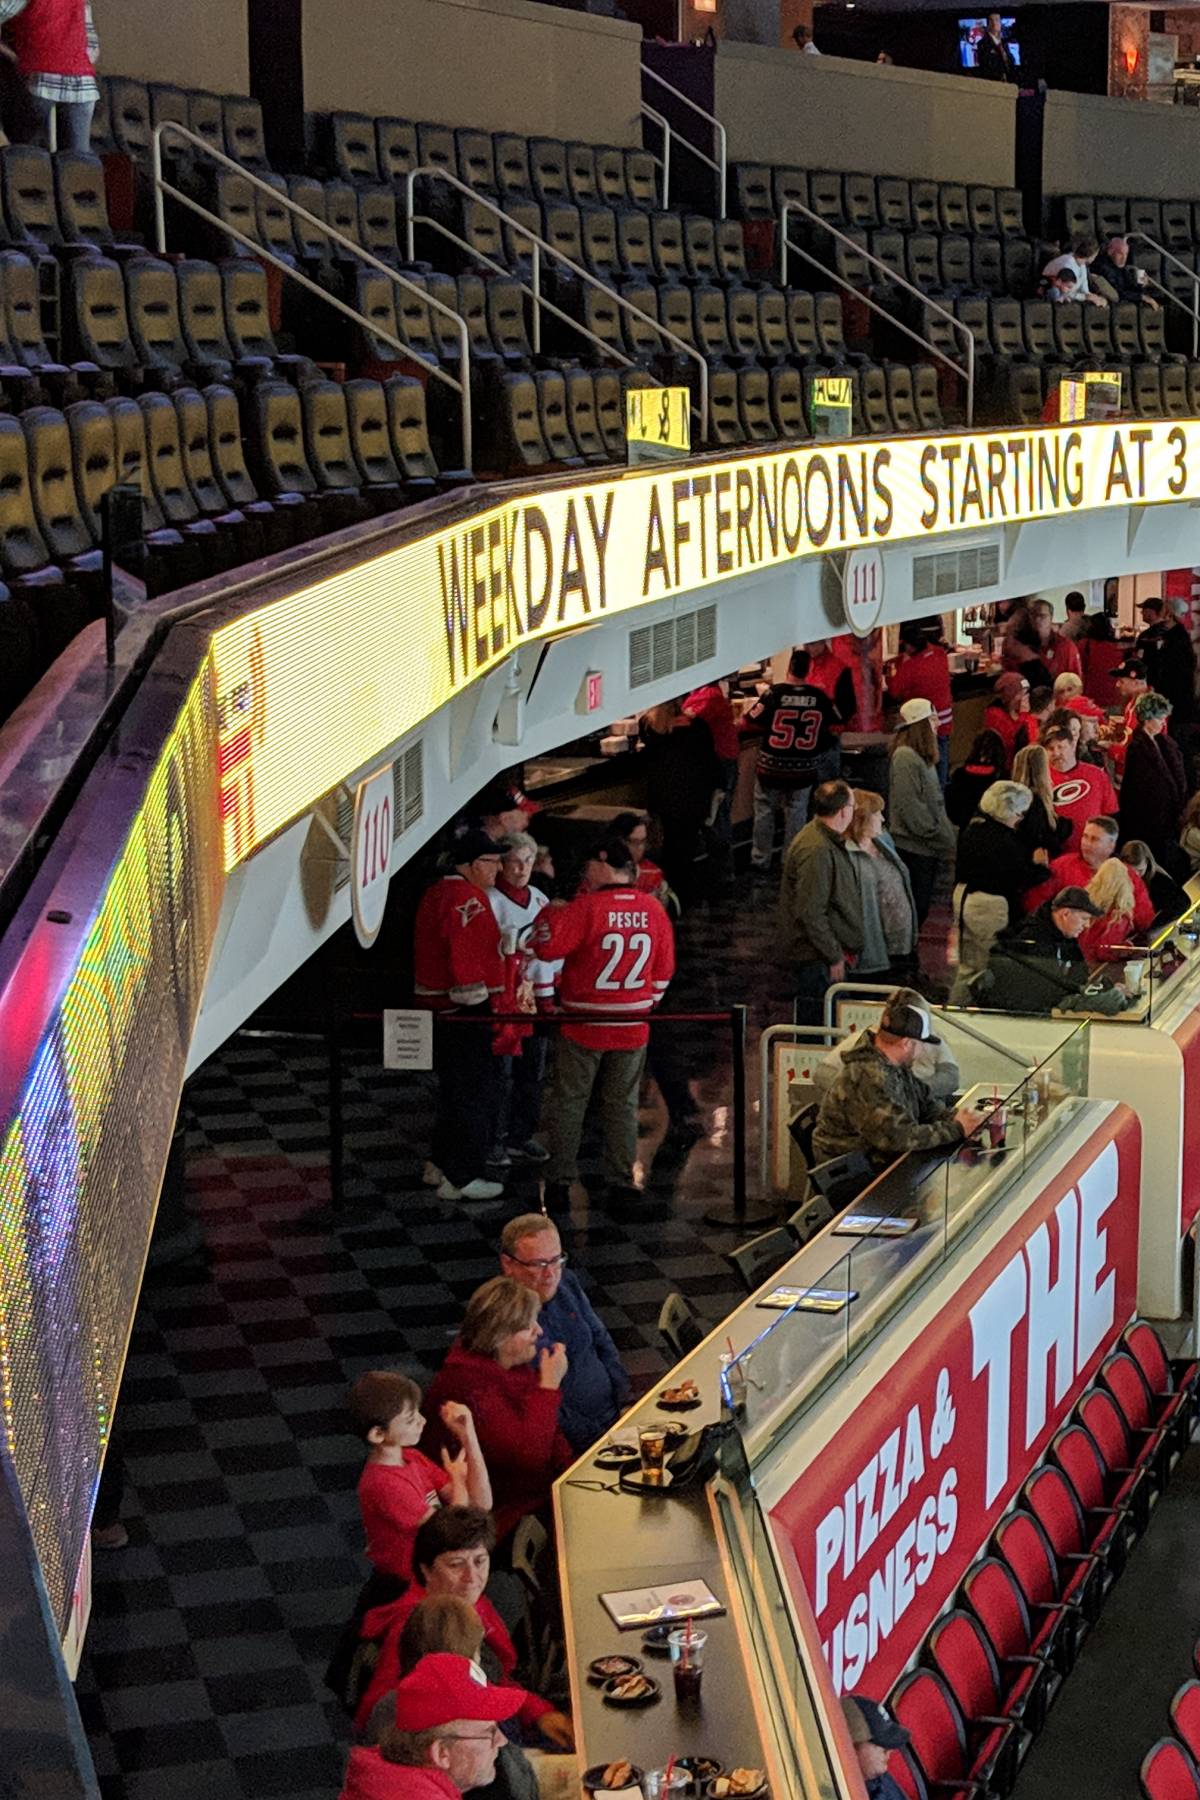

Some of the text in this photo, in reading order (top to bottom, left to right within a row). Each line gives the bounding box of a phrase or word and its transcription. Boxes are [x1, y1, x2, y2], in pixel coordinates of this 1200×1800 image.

[437, 491, 614, 687] WEEKDAY
[643, 447, 894, 596] AFTERNOONS
[921, 432, 1084, 529] STARTING
[1105, 430, 1153, 501] AT
[1167, 427, 1188, 495] 3
[852, 560, 878, 605] 111
[768, 709, 822, 750] 53
[362, 794, 390, 889] 110
[608, 911, 649, 928] PESCE
[595, 933, 652, 990] 22
[968, 1139, 1119, 1511] THE
[815, 1366, 957, 1618] PIZZA &
